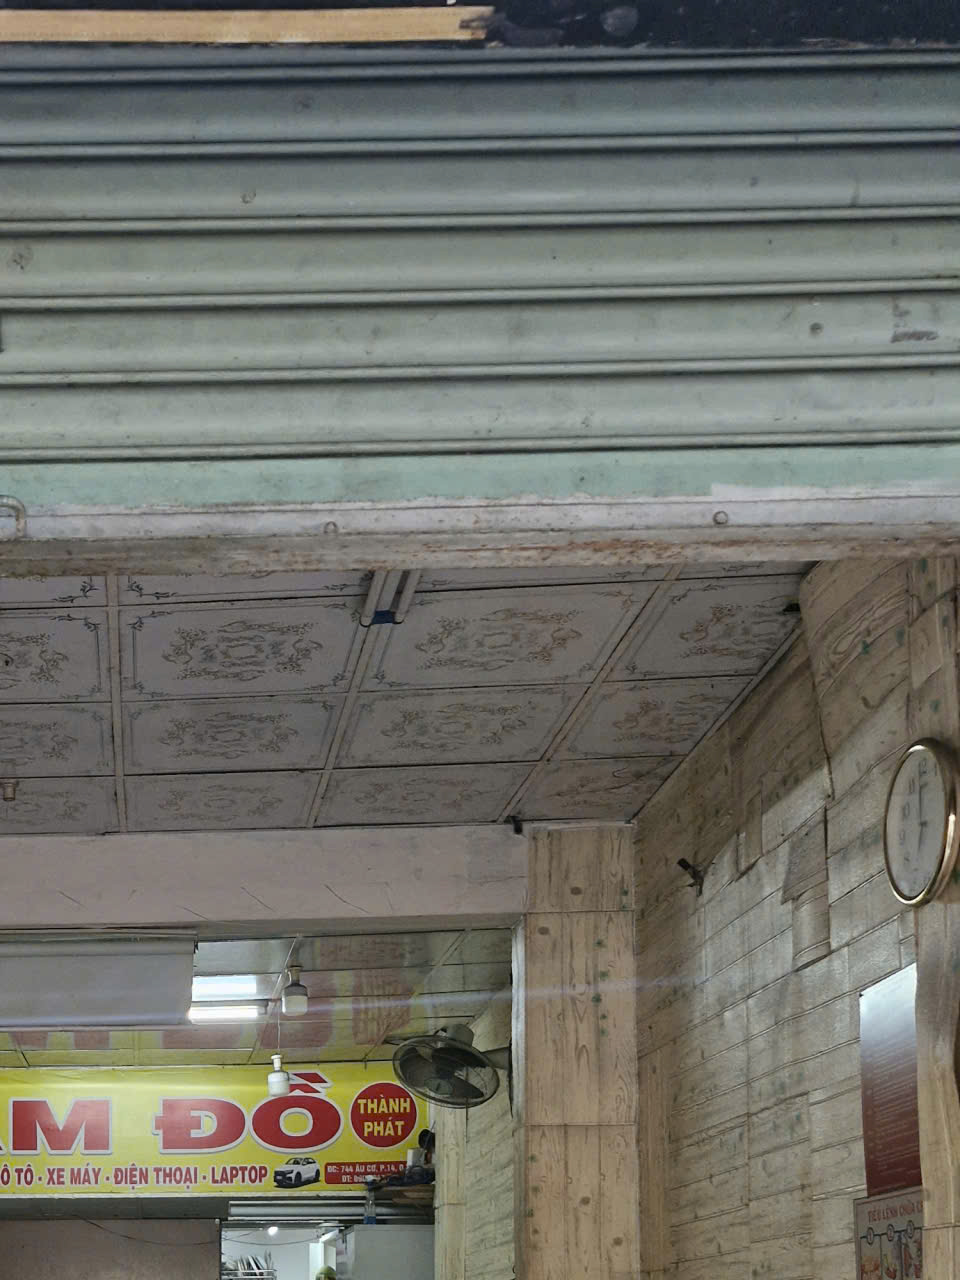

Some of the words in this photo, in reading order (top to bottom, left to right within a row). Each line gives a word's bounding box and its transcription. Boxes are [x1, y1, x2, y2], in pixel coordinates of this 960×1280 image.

[152, 1071, 344, 1154] ĐỒ
[357, 1094, 411, 1114] THÀNH
[363, 1117, 405, 1137] PHÁT
[0, 1164, 11, 1186] Ô
[14, 1164, 34, 1186] TÔ
[46, 1167, 65, 1186] XE
[70, 1162, 102, 1185] MÁY
[113, 1162, 149, 1191] ĐIỆN
[153, 1166, 198, 1190] THOẠI
[210, 1165, 268, 1184] LAPTOP
